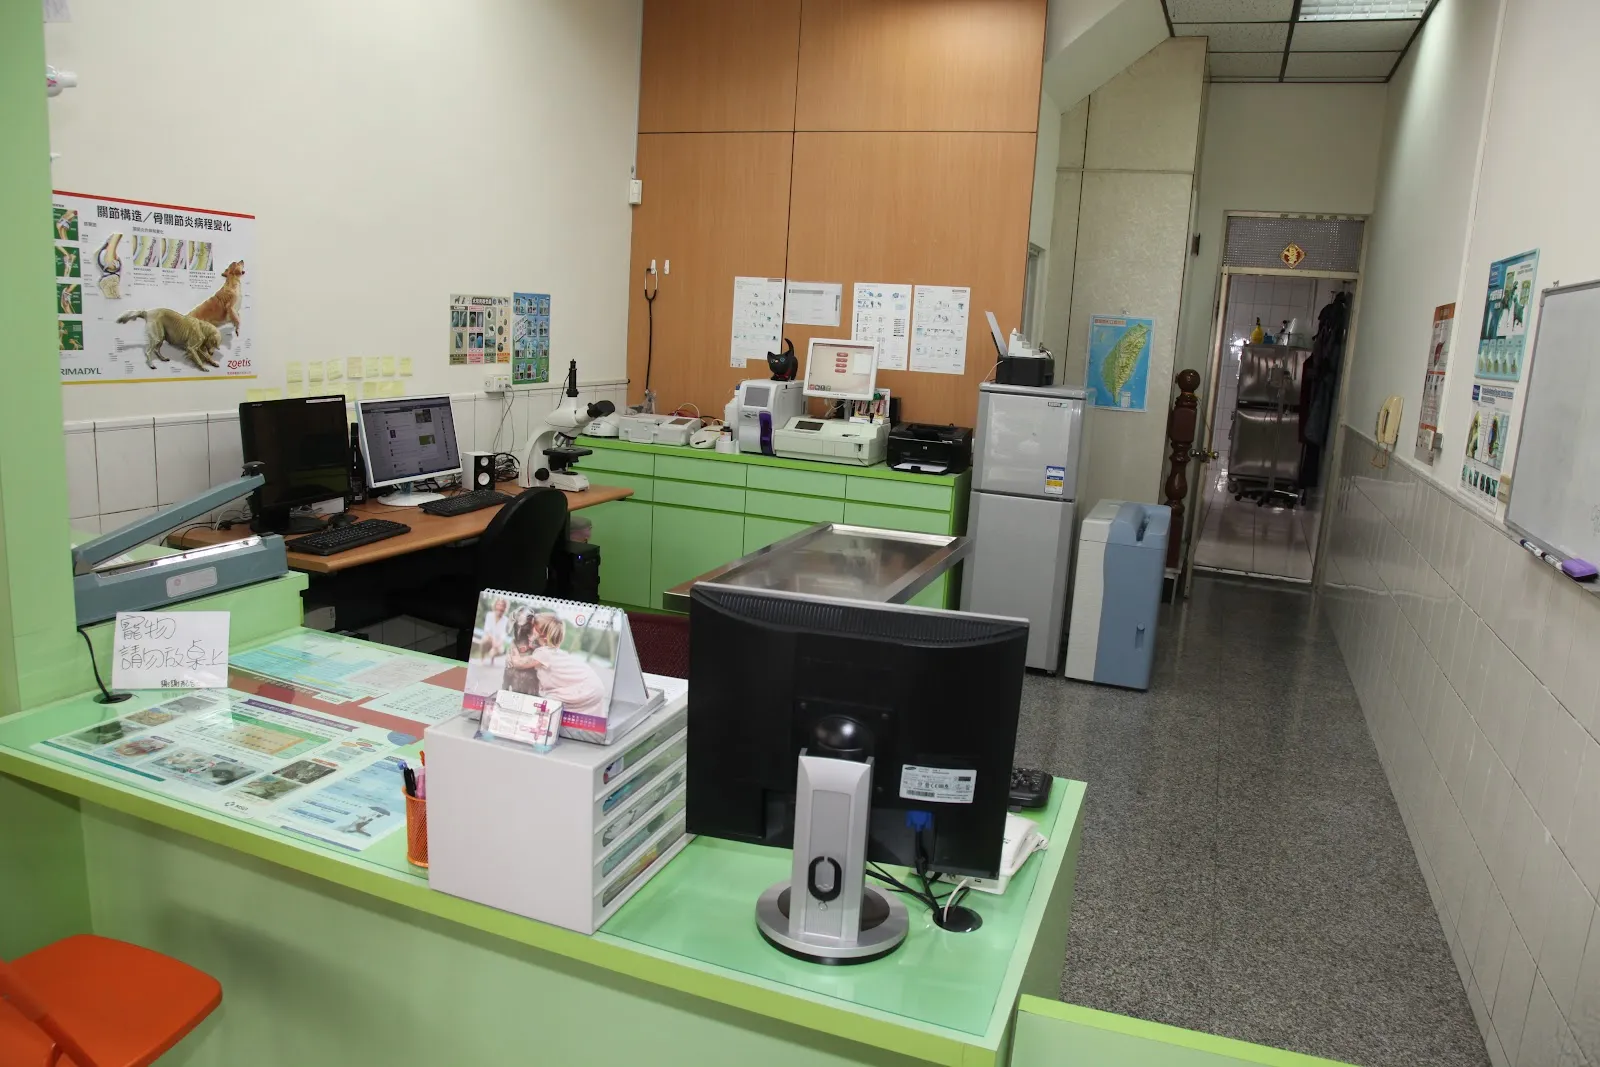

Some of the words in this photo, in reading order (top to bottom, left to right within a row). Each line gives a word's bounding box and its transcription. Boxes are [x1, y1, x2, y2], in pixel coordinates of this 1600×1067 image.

[227, 358, 252, 370] zoetis
[120, 615, 176, 640] 寵物
[118, 640, 226, 670] 請勿放桌上
